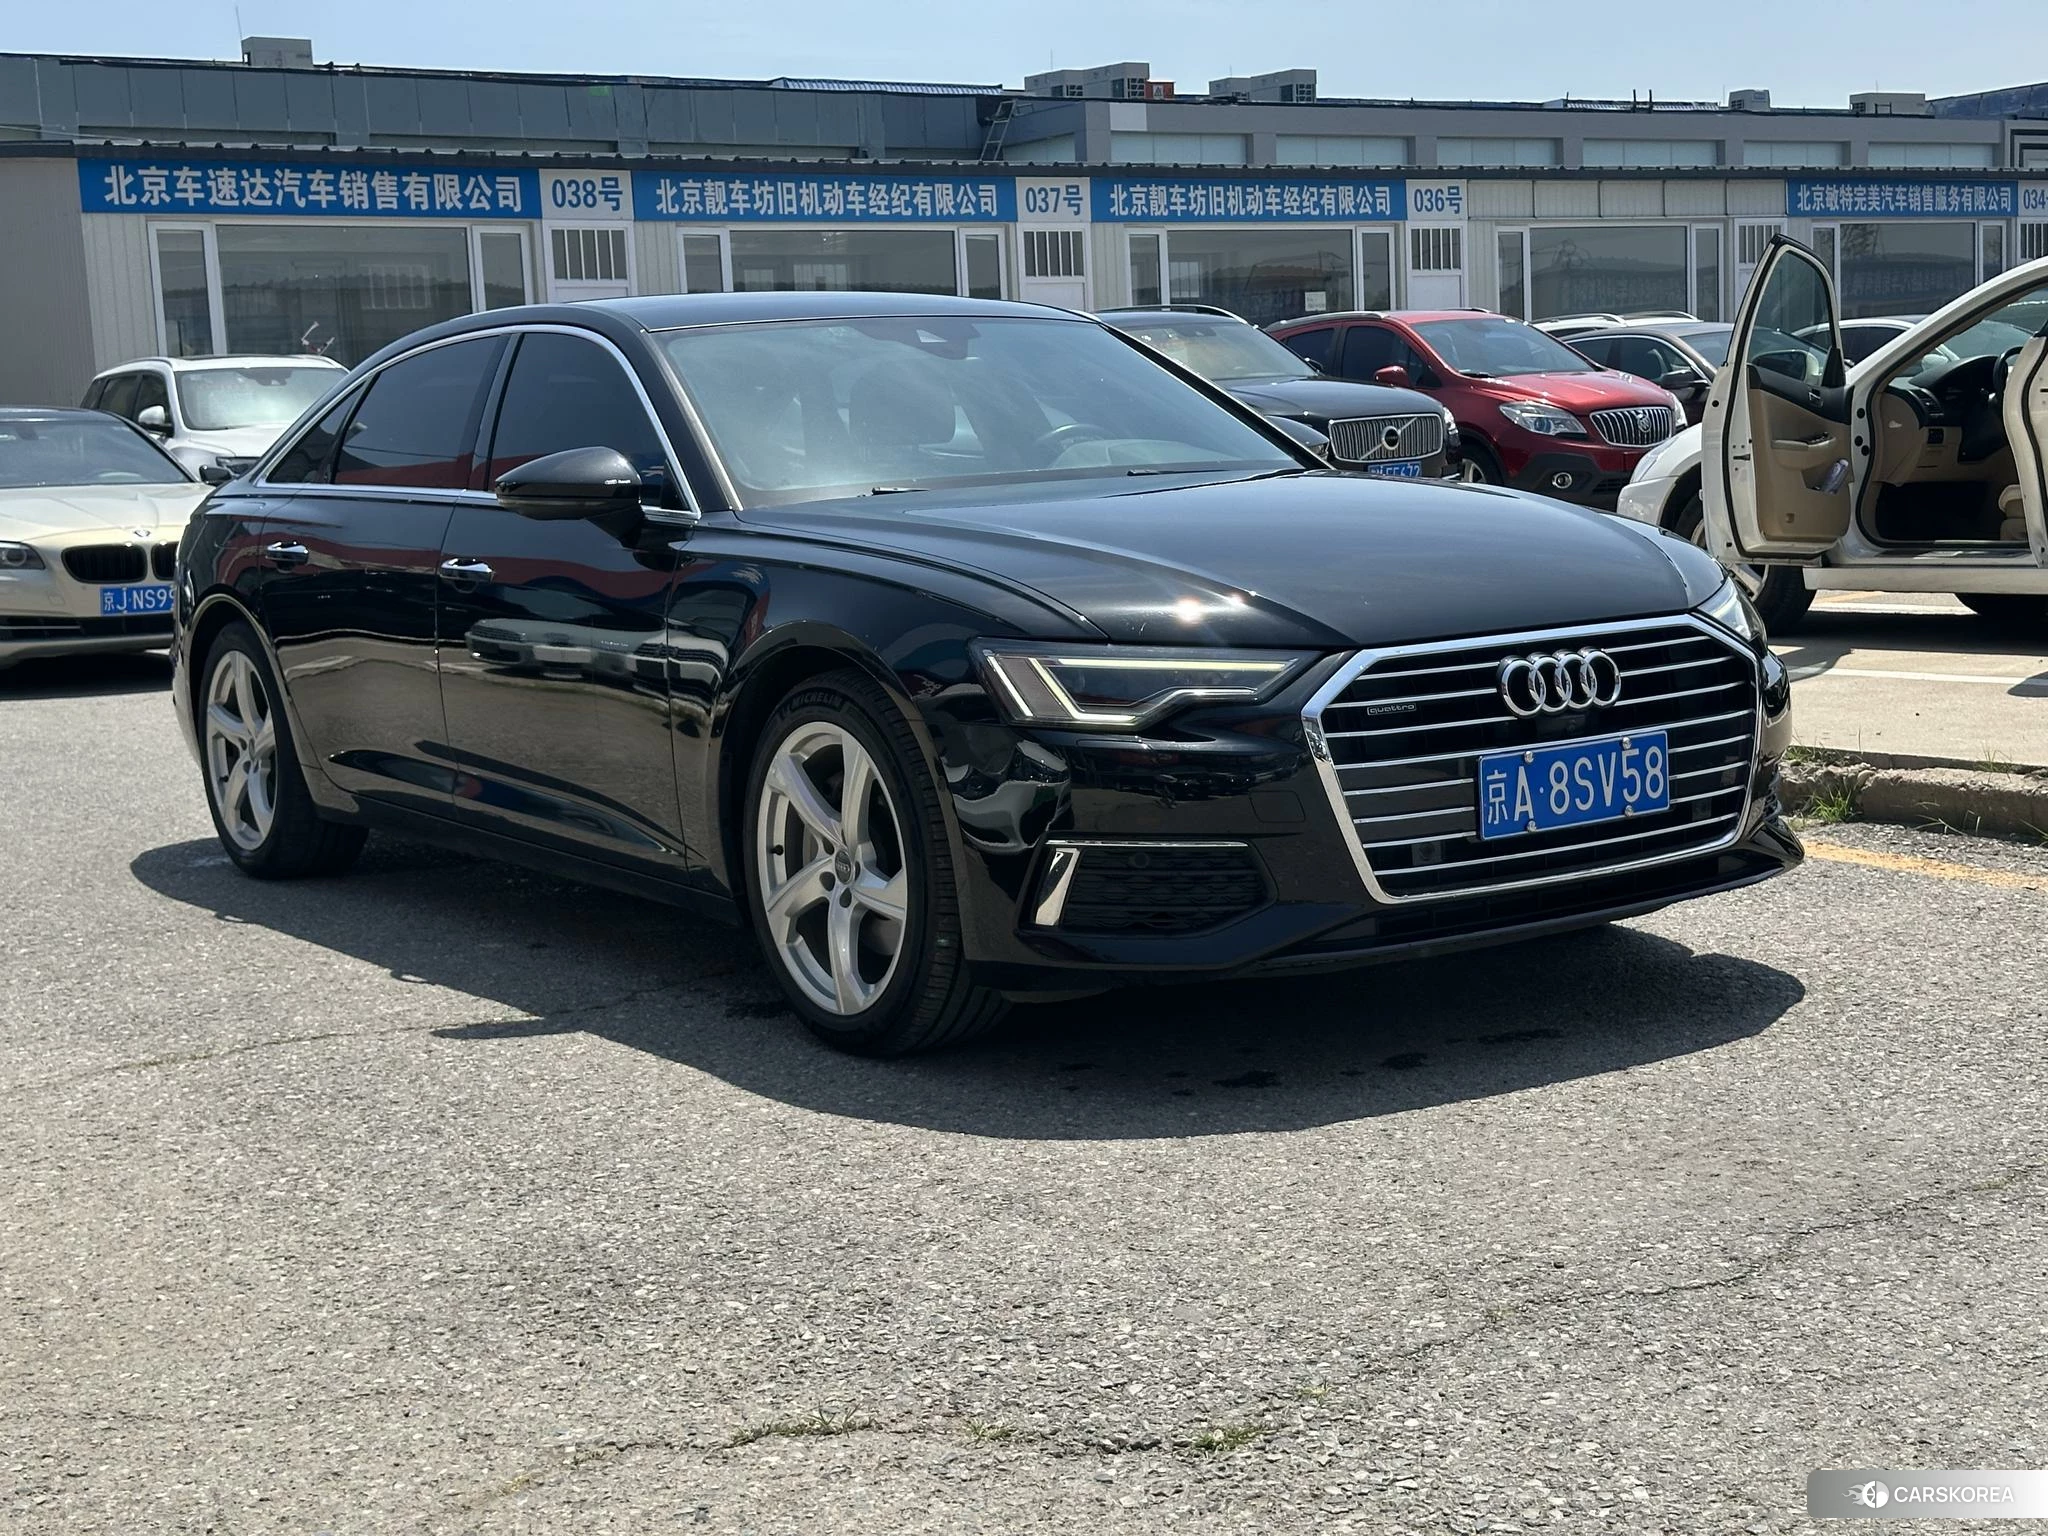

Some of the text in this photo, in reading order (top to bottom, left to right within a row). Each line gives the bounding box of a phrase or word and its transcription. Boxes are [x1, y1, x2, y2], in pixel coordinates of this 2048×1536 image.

[104, 165, 523, 213] 北京车速达汽车销售有限公司
[551, 176, 623, 212] 038号
[656, 178, 999, 217] 北京靓车坊旧机动车经纪有限公司
[1024, 184, 1082, 216] 037号
[1109, 184, 1392, 217] 北京靓车坊旧机动车经纪有限公司
[1413, 185, 1463, 215] 036号
[2023, 188, 2048, 210] 034
[1369, 704, 1416, 715] quattro
